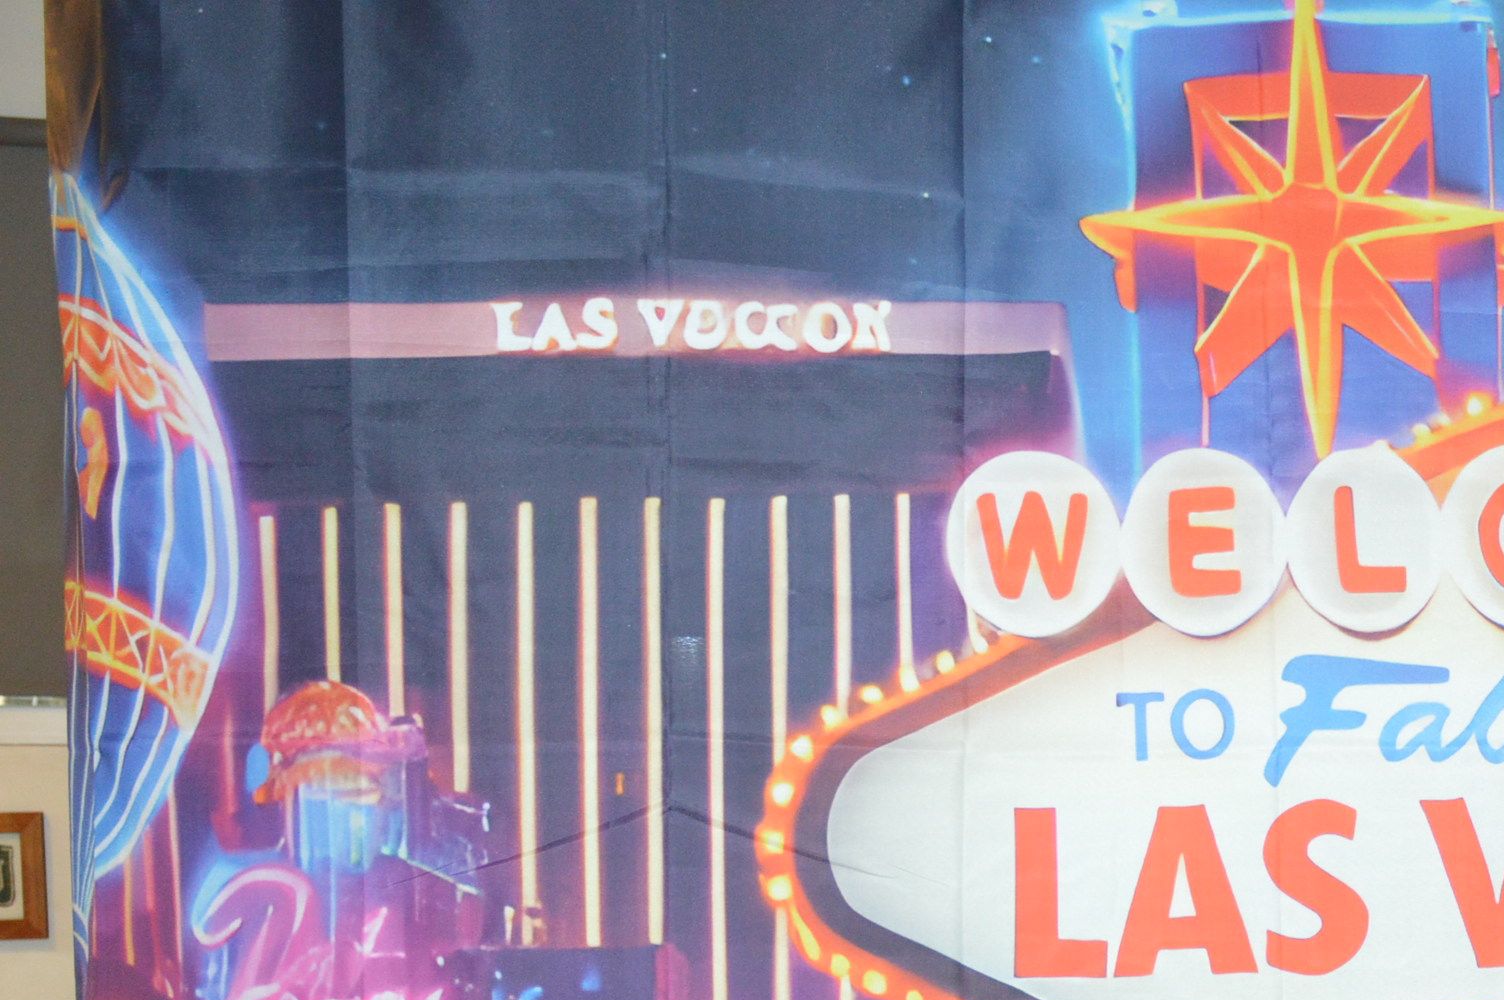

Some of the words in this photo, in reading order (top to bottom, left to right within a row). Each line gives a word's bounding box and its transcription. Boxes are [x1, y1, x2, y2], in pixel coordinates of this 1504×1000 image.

[490, 297, 619, 352] LAS
[1116, 690, 1236, 762] TO
[1013, 798, 1370, 978] LAS
